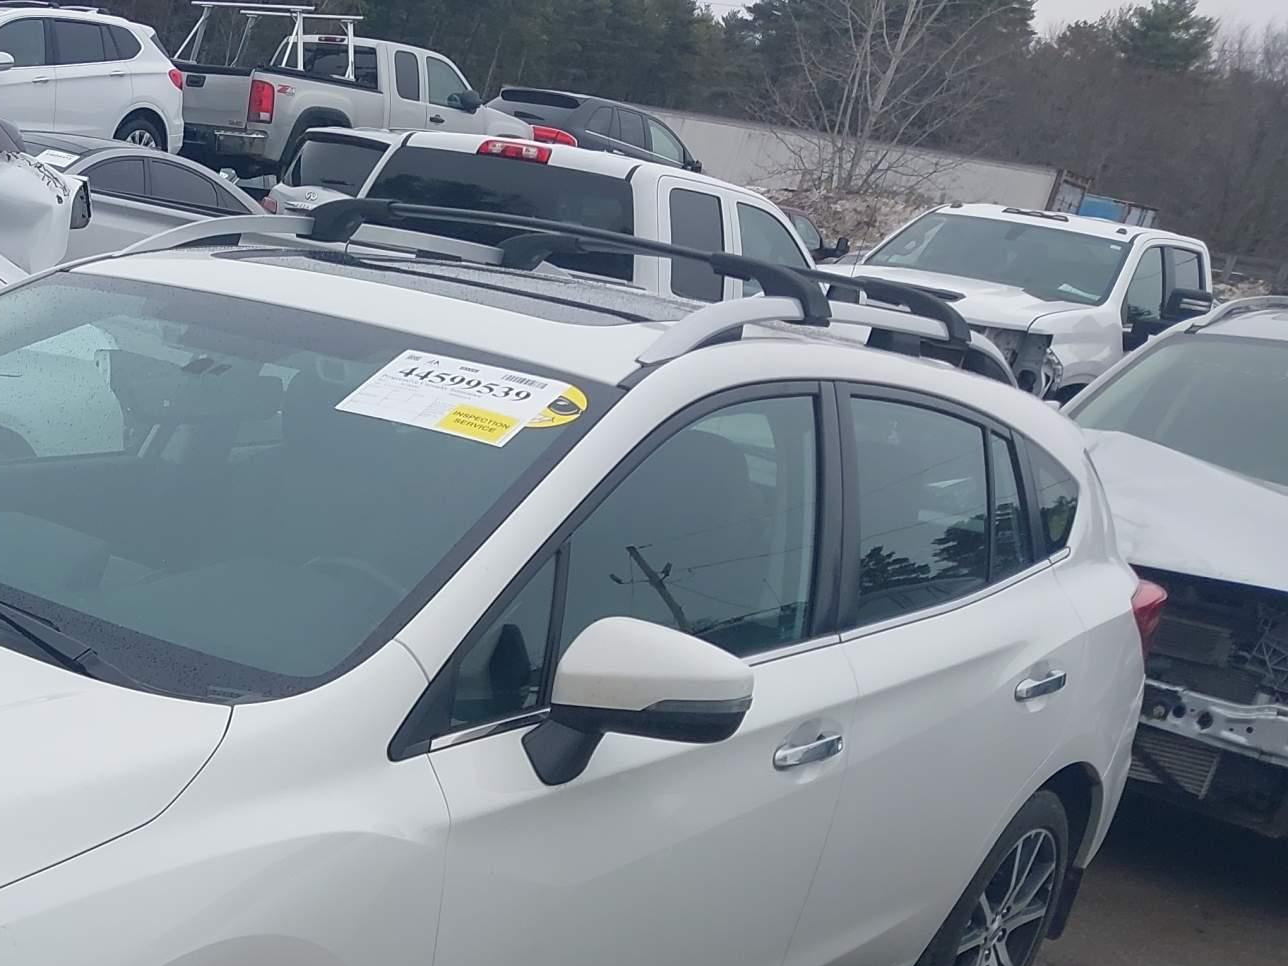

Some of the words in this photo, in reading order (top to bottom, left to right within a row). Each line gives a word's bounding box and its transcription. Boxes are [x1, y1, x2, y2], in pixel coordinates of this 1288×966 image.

[399, 366, 532, 402] 44599539
[452, 410, 511, 430] INSPECTION
[454, 418, 497, 433] SERVICE
